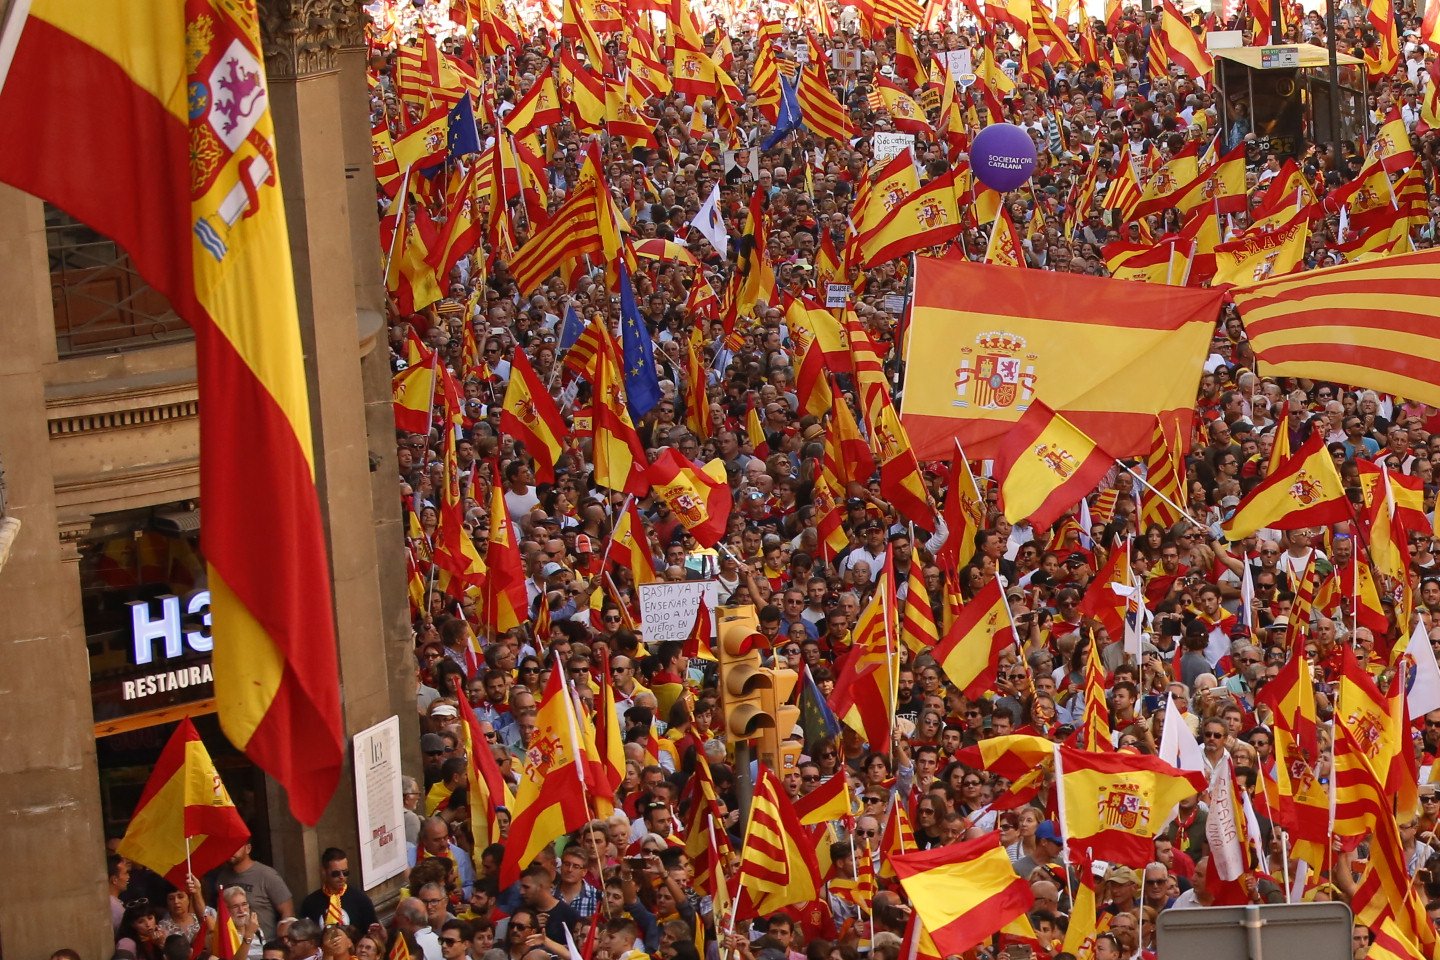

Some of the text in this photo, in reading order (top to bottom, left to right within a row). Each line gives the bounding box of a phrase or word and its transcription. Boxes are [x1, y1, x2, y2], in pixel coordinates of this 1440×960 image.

[988, 155, 1019, 164] SOCIETAT
[988, 161, 1023, 170] CATALANA
[642, 582, 711, 602] BASTA YA DE
[645, 597, 687, 613] ENSEÑAR
[678, 620, 688, 629] EN
